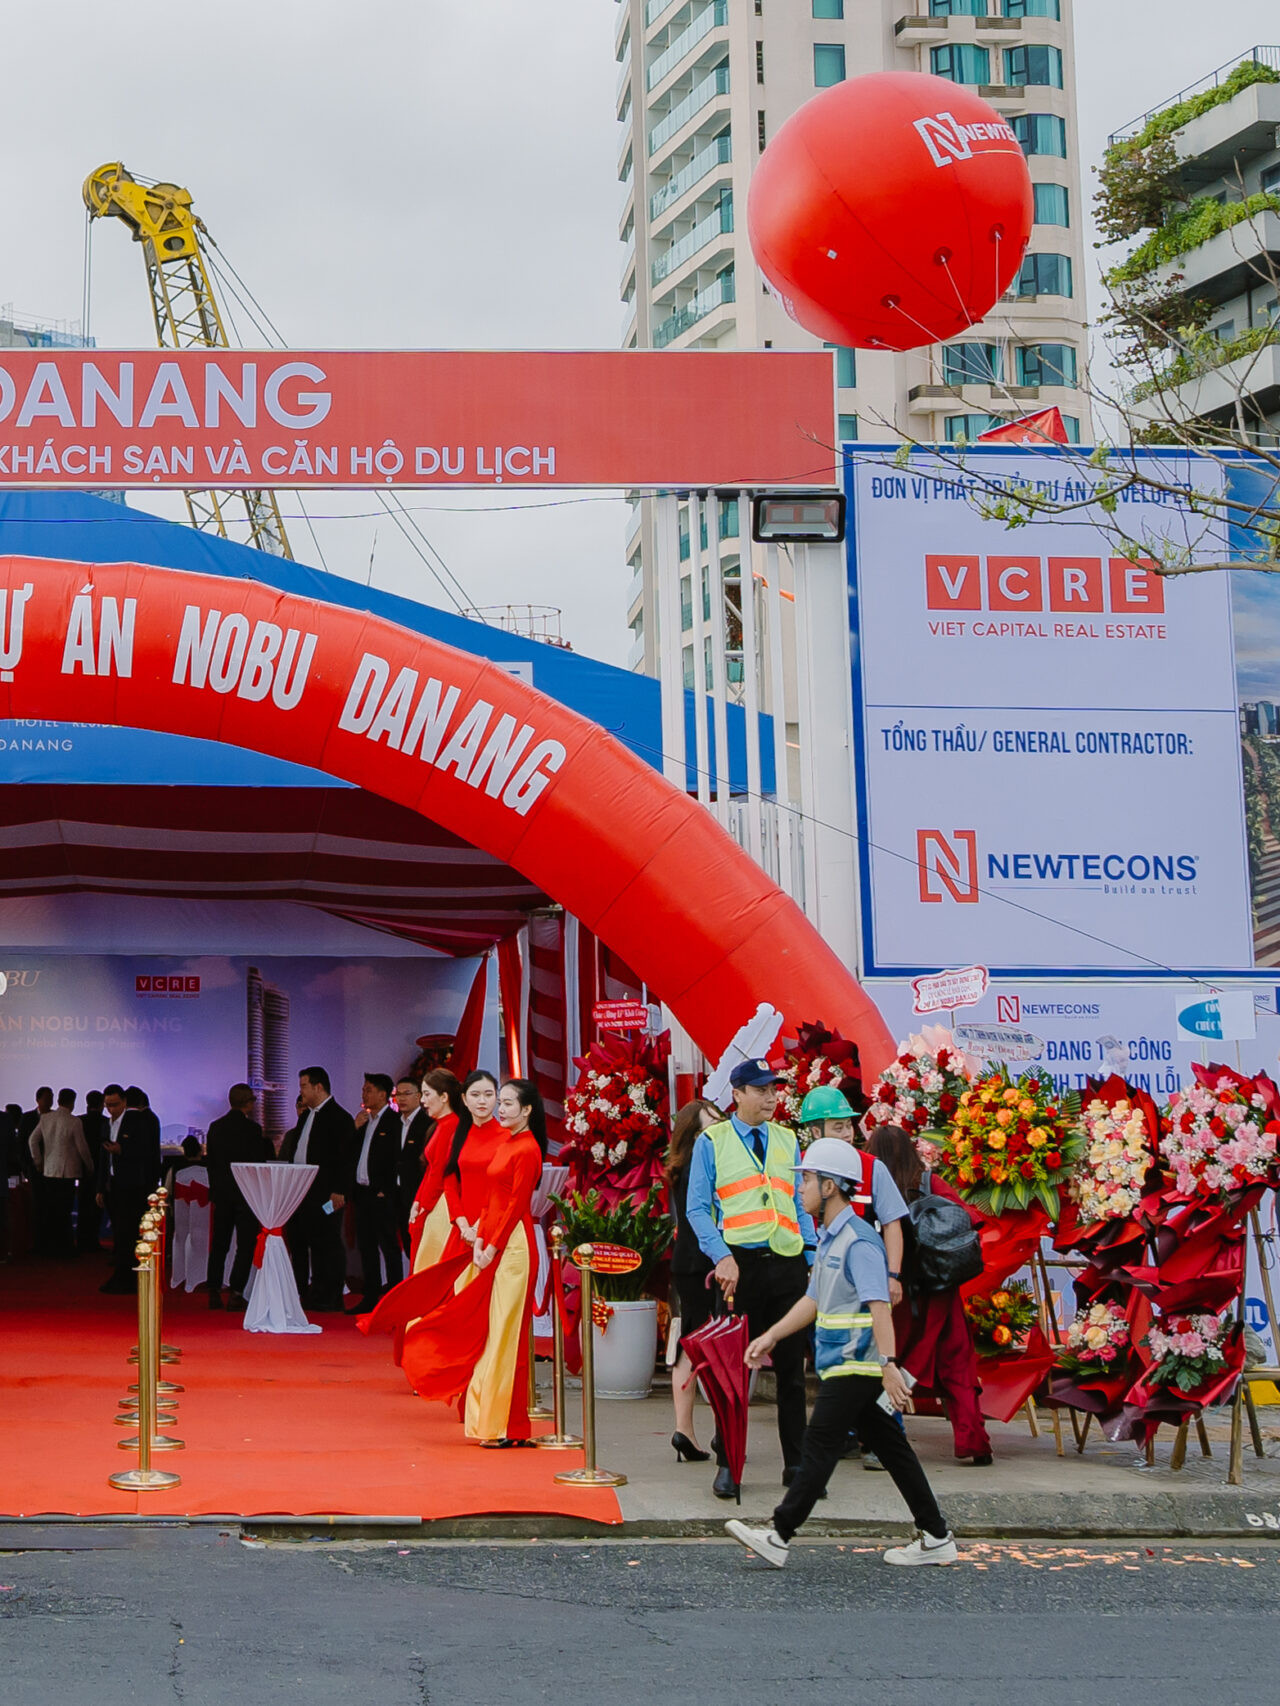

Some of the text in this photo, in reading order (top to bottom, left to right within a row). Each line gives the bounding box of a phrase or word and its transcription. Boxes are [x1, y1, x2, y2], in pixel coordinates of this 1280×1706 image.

[122, 445, 196, 482] SẠN
[205, 438, 252, 475] VÀ
[261, 441, 338, 475] CĂN
[350, 438, 404, 483] HỘ
[414, 446, 466, 475] DU
[477, 446, 556, 483] LỊCH
[871, 476, 908, 500] ĐƠN
[913, 477, 929, 504] VỊ
[933, 474, 977, 500] PHÁT
[931, 560, 1156, 608] VCRE
[927, 621, 1167, 640] VIET CAPITAL REAL ESTATE
[60, 584, 138, 679] ÁN
[170, 604, 320, 712] NOBU
[337, 652, 568, 817] DANANG
[880, 719, 1194, 755] TỔNG THẦU/ GENERAL CONTRACTOR:
[987, 853, 1197, 881] NEWTECONS
[1160, 885, 1198, 895] trust
[138, 978, 198, 990] VCRE
[1022, 1003, 1100, 1015] NEWTECONS
[30, 1015, 89, 1031] NOBU
[95, 1016, 183, 1032] DANANG
[1046, 1039, 1092, 1061] ĐANG
[1128, 1036, 1172, 1061] CÔNG
[1156, 1065, 1181, 1093] LỖI
